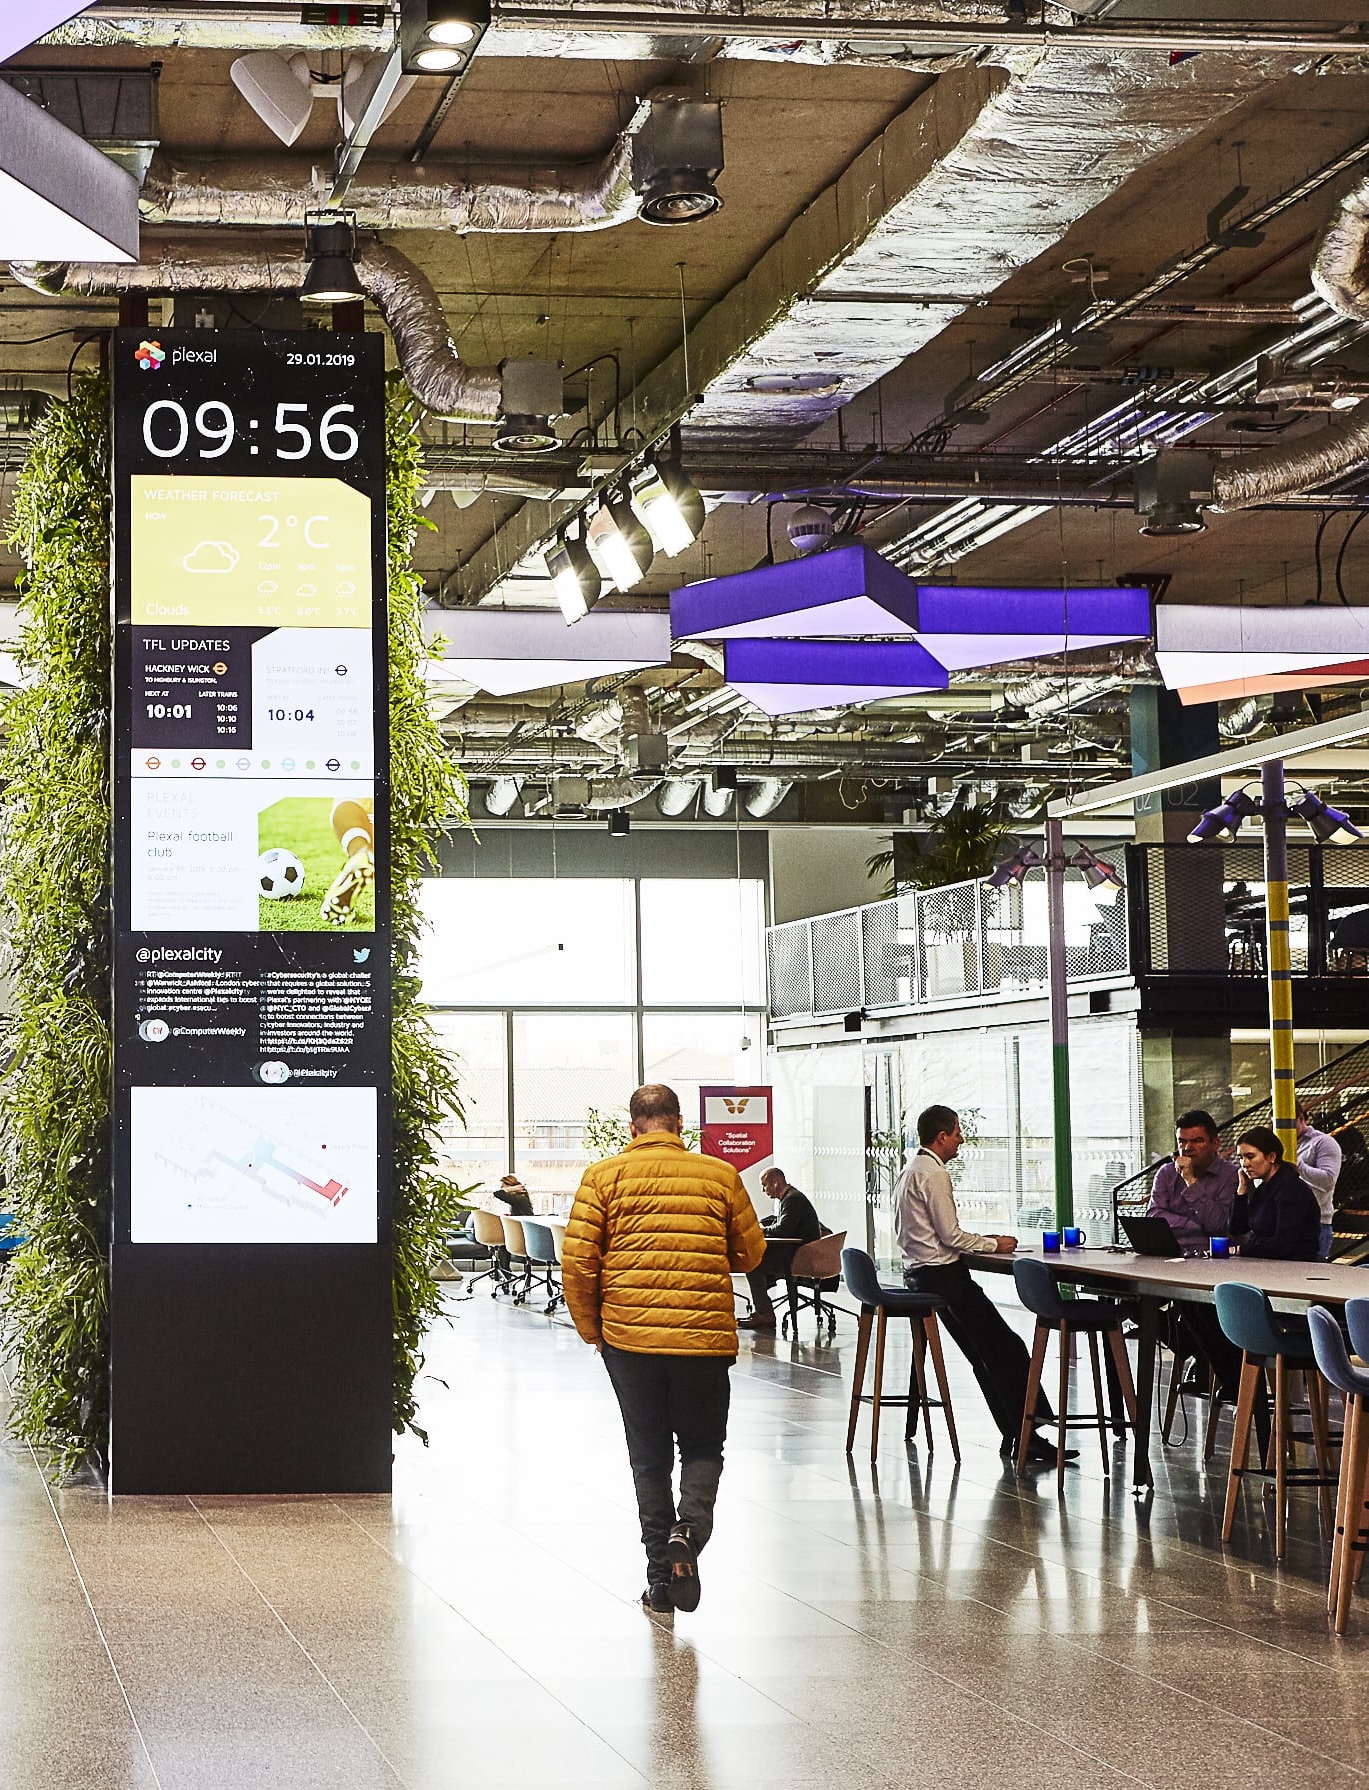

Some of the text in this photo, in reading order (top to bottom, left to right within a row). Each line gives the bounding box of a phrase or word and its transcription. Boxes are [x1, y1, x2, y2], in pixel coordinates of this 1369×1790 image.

[172, 347, 217, 365] plexal
[286, 353, 356, 366] 29.01.2019
[142, 400, 359, 461] 09:56
[144, 489, 280, 502] WEATHER FORECAST
[146, 604, 190, 616] Clouds
[143, 639, 230, 651] TFL UPDATES
[145, 664, 211, 673] HACKNEY WICK
[146, 704, 193, 719] 10:01
[268, 709, 316, 721] 10:04
[217, 715, 237, 723] 10:10
[148, 831, 233, 842] Plexal football
[148, 847, 172, 857] club
[136, 947, 223, 963] @plexalcity
[328, 972, 349, 980] global
[282, 981, 307, 989] requires
[315, 981, 335, 989] global
[286, 989, 316, 997] delighted
[293, 997, 326, 1005] partnering
[147, 1005, 166, 1013] global
[173, 1027, 246, 1037] @ComputerWeekly
